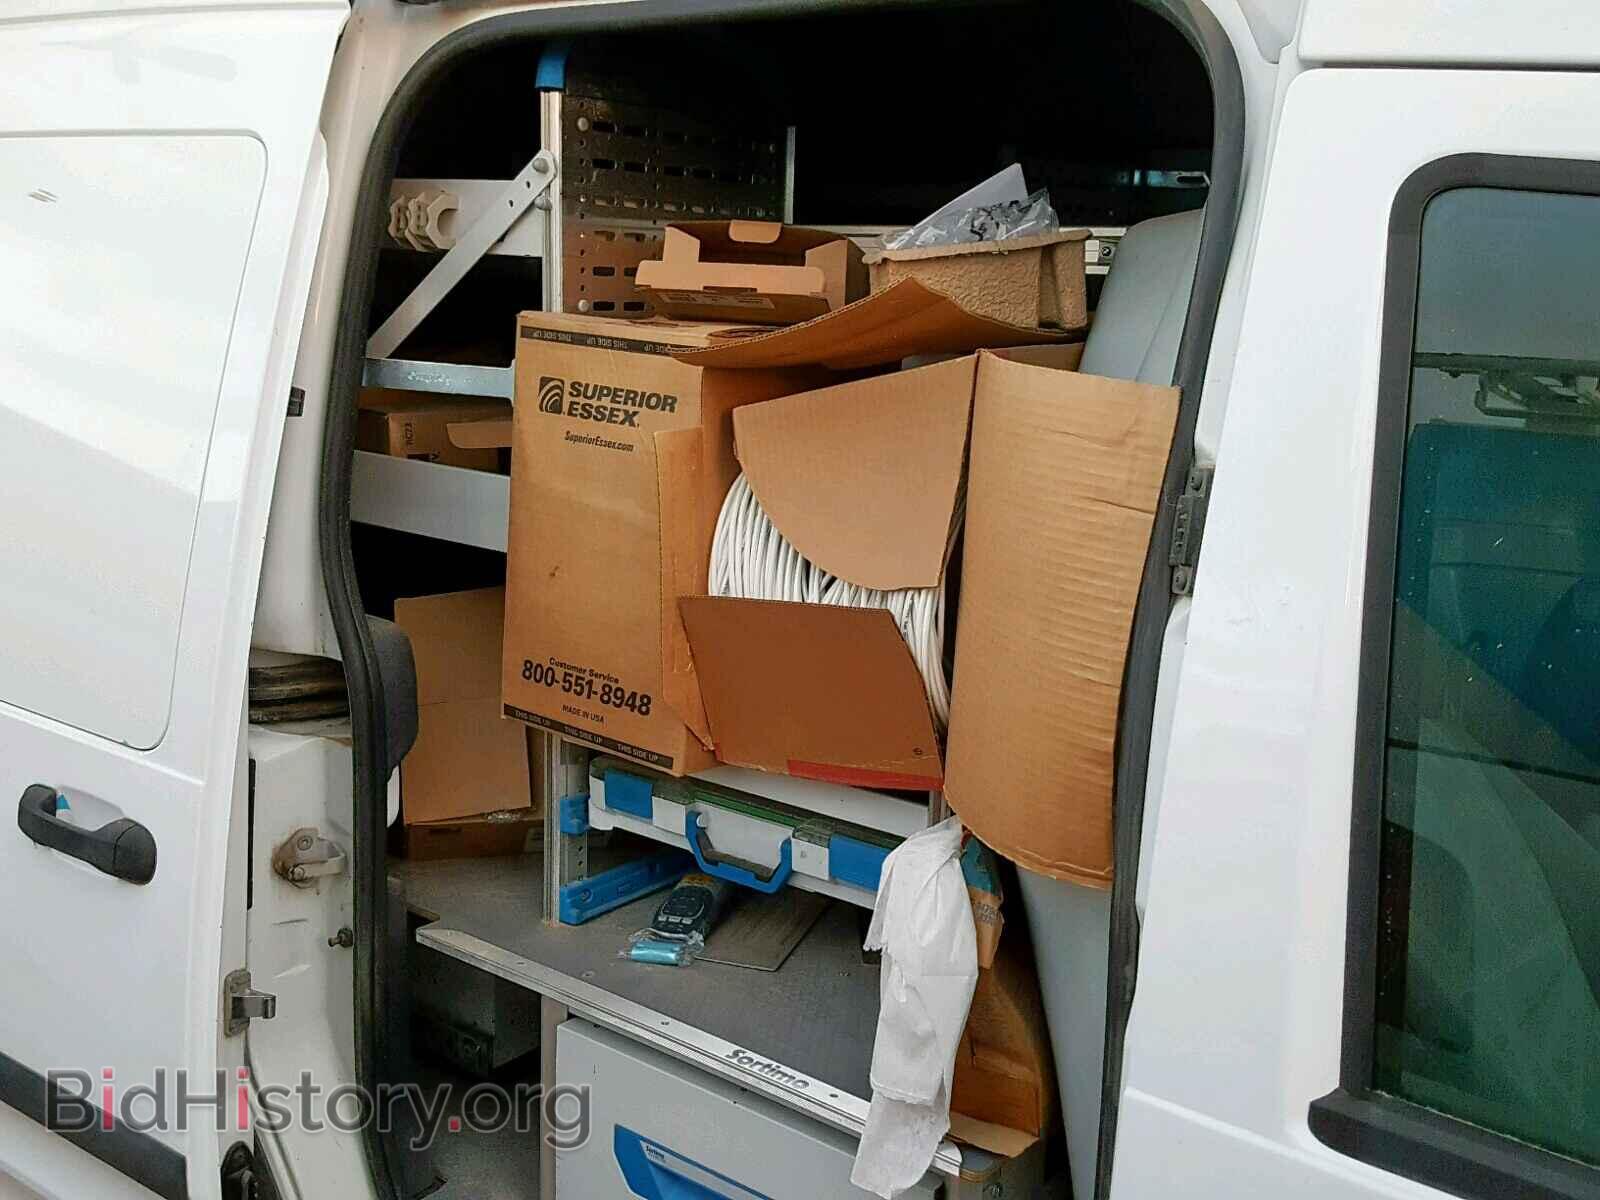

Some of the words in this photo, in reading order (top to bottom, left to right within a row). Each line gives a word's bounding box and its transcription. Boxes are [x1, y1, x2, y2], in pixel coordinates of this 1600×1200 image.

[586, 336, 596, 345] UP
[598, 338, 612, 347] SIDE
[613, 339, 628, 349] THIS
[568, 380, 678, 413] SUPERIOR
[567, 401, 640, 428] ESSEX
[564, 430, 635, 452] SuperiorEssex.com
[549, 657, 587, 675] Customer
[588, 668, 620, 685] Service
[522, 659, 652, 716] 800-551-8948
[515, 710, 529, 720] THIS
[529, 713, 542, 723] SIDE
[542, 717, 551, 726] UP
[562, 704, 582, 717] MADE
[582, 710, 590, 719] IN
[590, 711, 604, 723] USA
[564, 727, 578, 738] THIS
[579, 730, 593, 741] SIDE
[593, 734, 603, 744] UP
[617, 743, 631, 754] THIS
[632, 748, 648, 758] SIDE
[648, 753, 658, 761] UP
[725, 1048, 810, 1090] Sortimo
